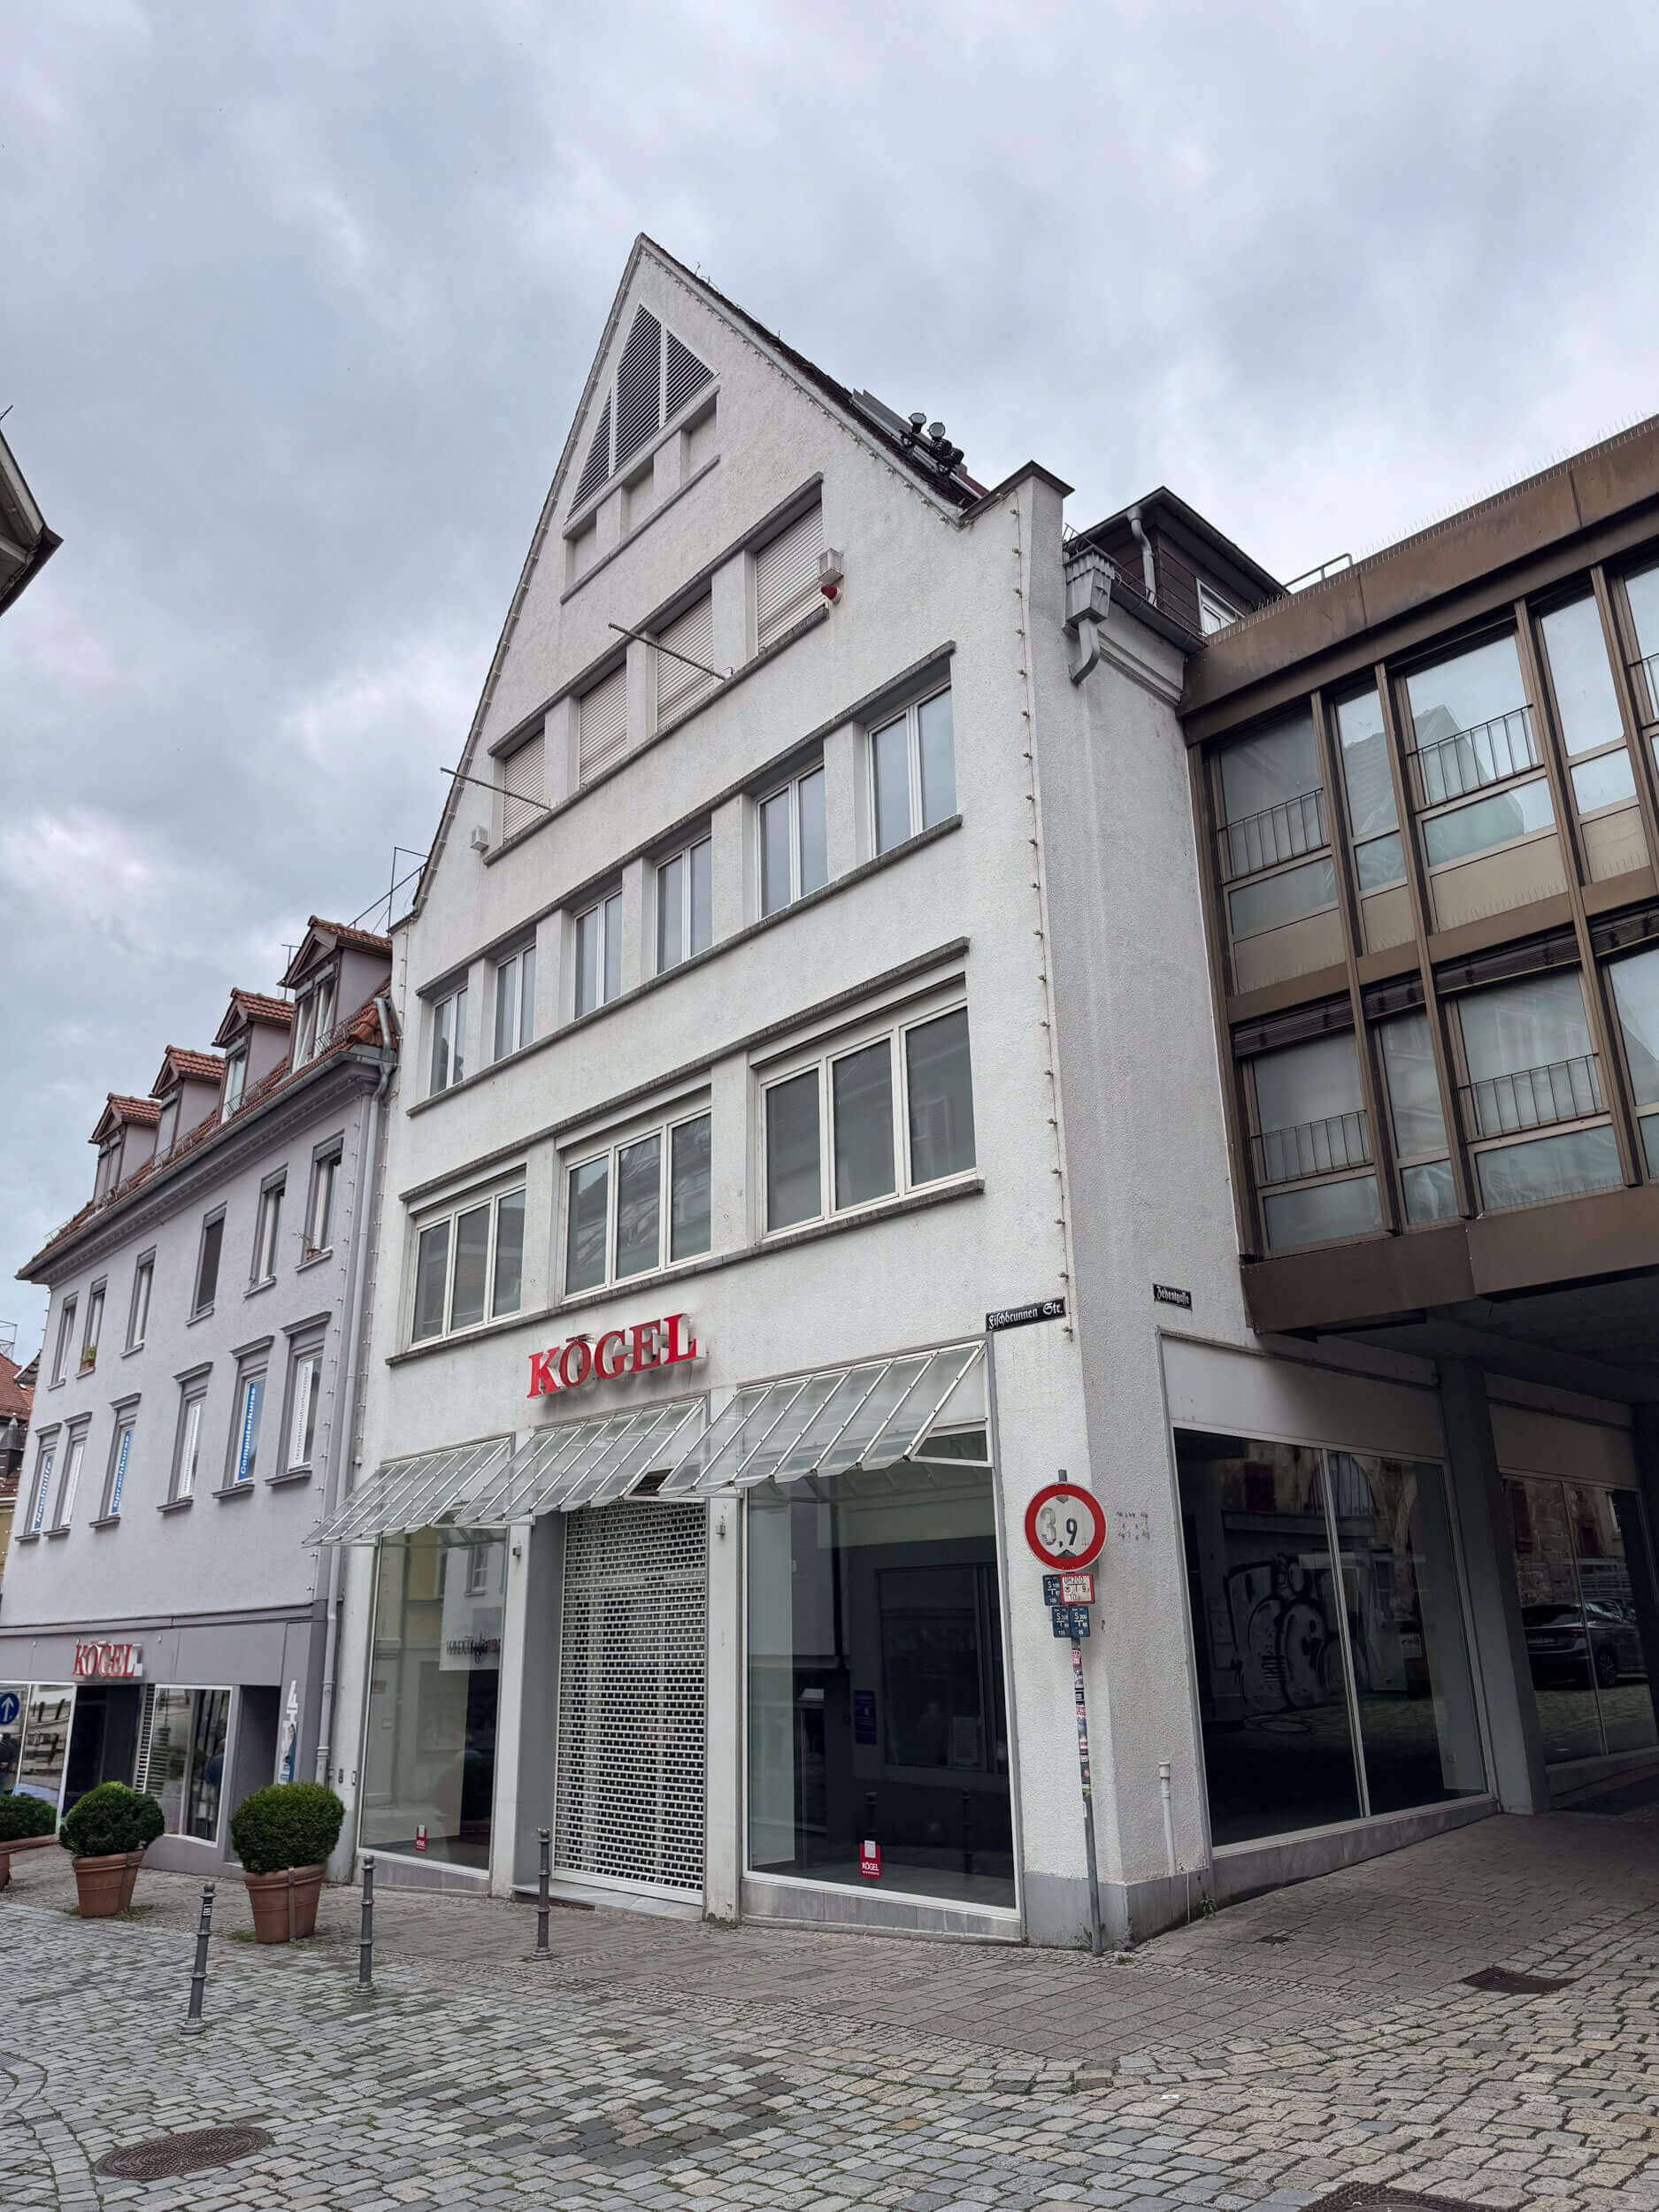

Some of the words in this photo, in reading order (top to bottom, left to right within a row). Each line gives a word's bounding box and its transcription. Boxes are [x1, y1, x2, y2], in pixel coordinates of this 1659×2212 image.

[988, 1308, 1039, 1330] Fischbrunnen
[1043, 1302, 1064, 1316] Str.
[526, 1314, 697, 1398] KÖGEL
[240, 1386, 256, 1475] Computerkurse
[36, 1460, 51, 1523] Nachhilfe
[112, 1433, 130, 1508] Sprachkurse
